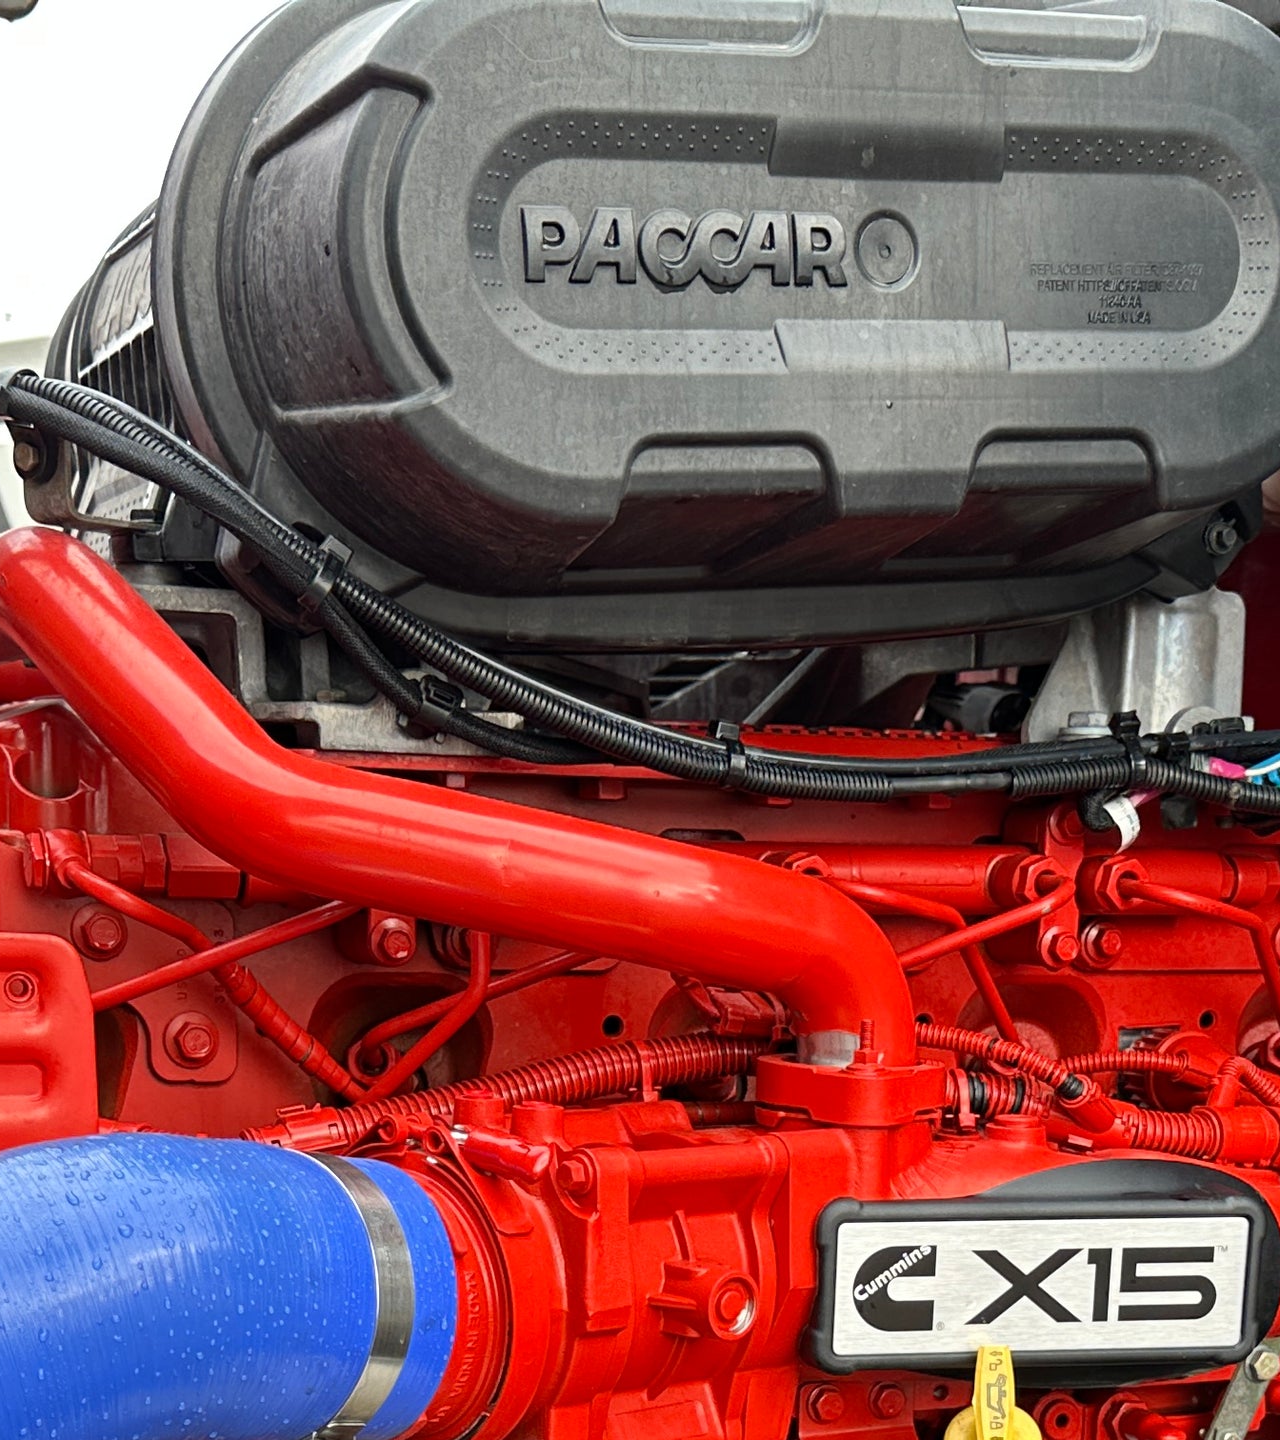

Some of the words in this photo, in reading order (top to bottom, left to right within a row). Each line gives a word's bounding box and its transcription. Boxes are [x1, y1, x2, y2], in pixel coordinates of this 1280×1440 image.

[520, 205, 847, 289] PACCAR
[853, 1244, 932, 1301] Cummins
[964, 1246, 1217, 1325] X15
